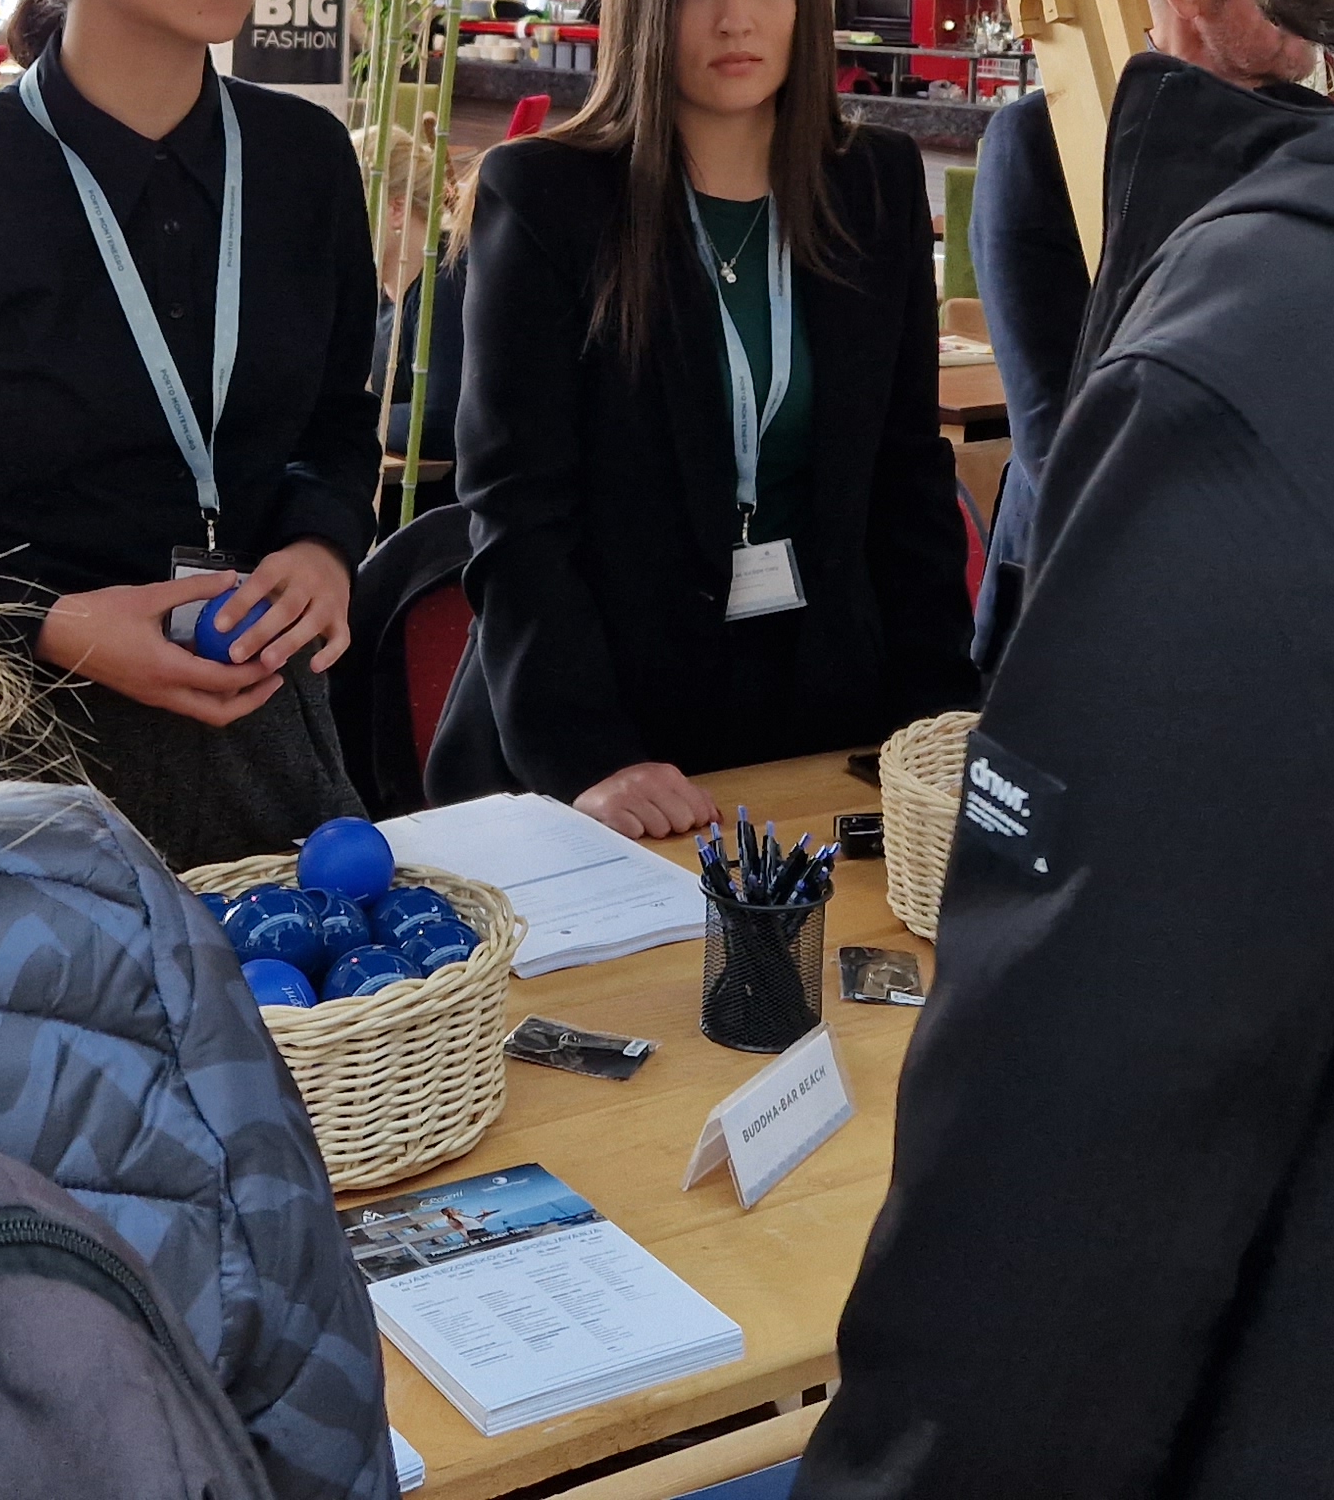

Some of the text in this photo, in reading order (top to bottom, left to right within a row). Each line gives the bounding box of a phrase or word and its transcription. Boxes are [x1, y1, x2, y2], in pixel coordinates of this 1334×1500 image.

[253, 30, 337, 48] FASHION
[88, 189, 124, 272] PORTO MONTENEGRO
[160, 368, 175, 396] PORTO
[742, 1065, 826, 1143] BUDDHA-BAR BEACH
